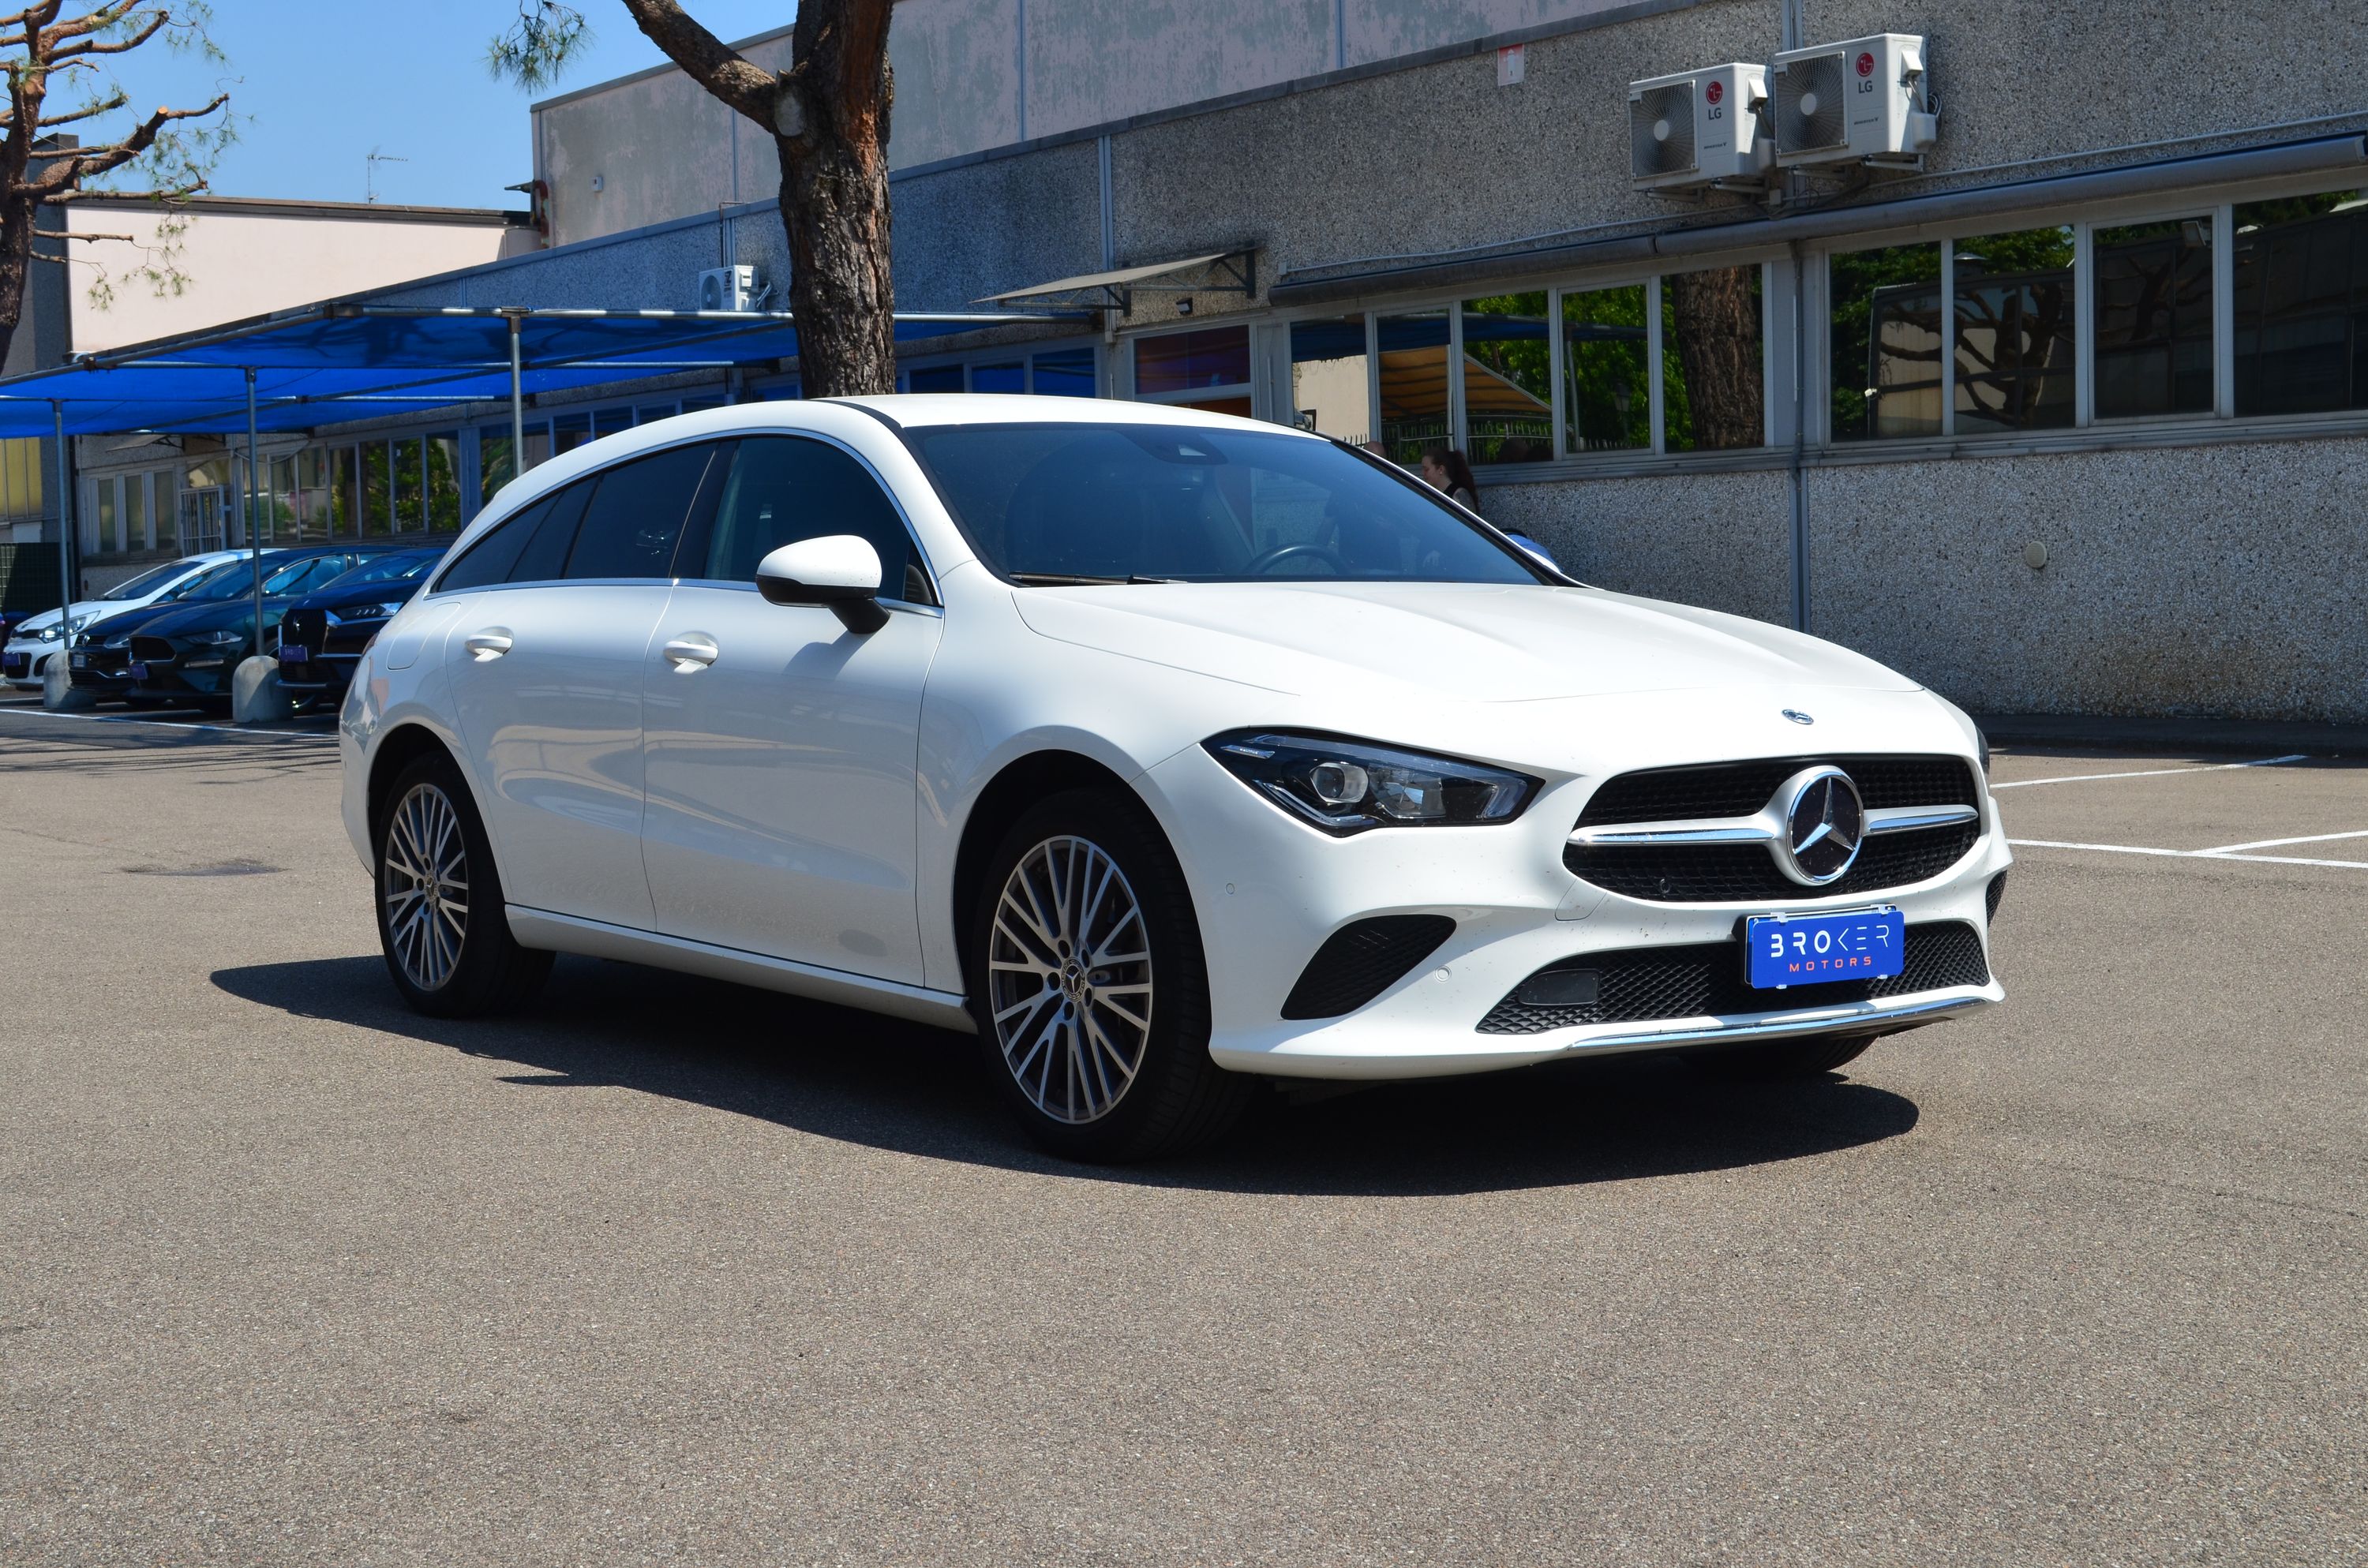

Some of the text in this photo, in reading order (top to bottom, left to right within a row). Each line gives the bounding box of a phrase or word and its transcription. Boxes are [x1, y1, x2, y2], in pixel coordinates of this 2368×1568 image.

[1858, 80, 1873, 94] LG
[1708, 107, 1722, 121] LG
[1770, 925, 1890, 958] BROKER
[1789, 956, 1872, 972] MOTORS
